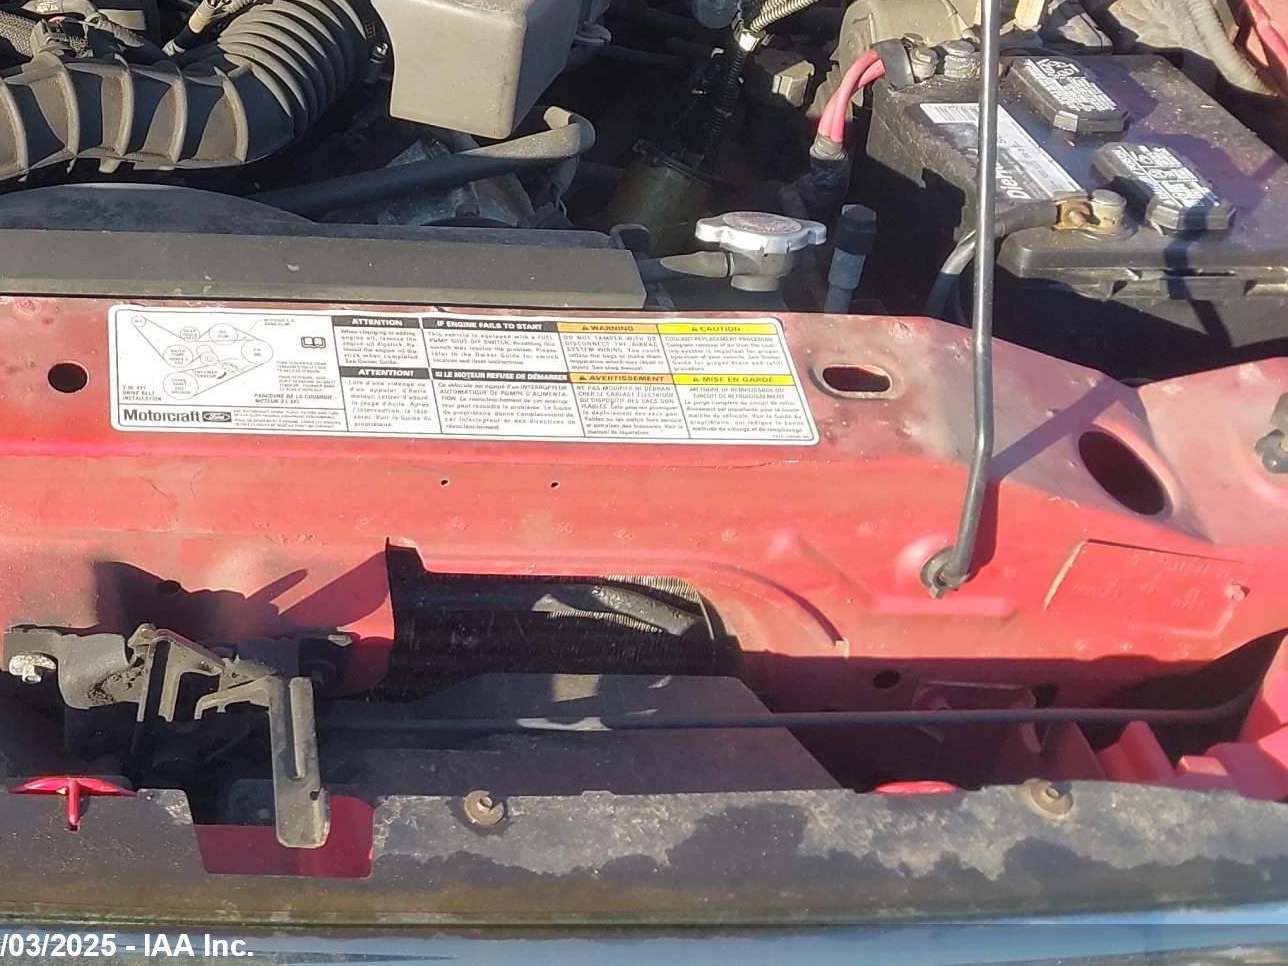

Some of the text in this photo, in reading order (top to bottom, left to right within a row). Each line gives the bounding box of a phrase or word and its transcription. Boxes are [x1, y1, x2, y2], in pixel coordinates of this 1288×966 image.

[350, 318, 402, 326] ATTENTION
[357, 368, 414, 376] ATTENTION!
[123, 408, 200, 422] Motorcraft
